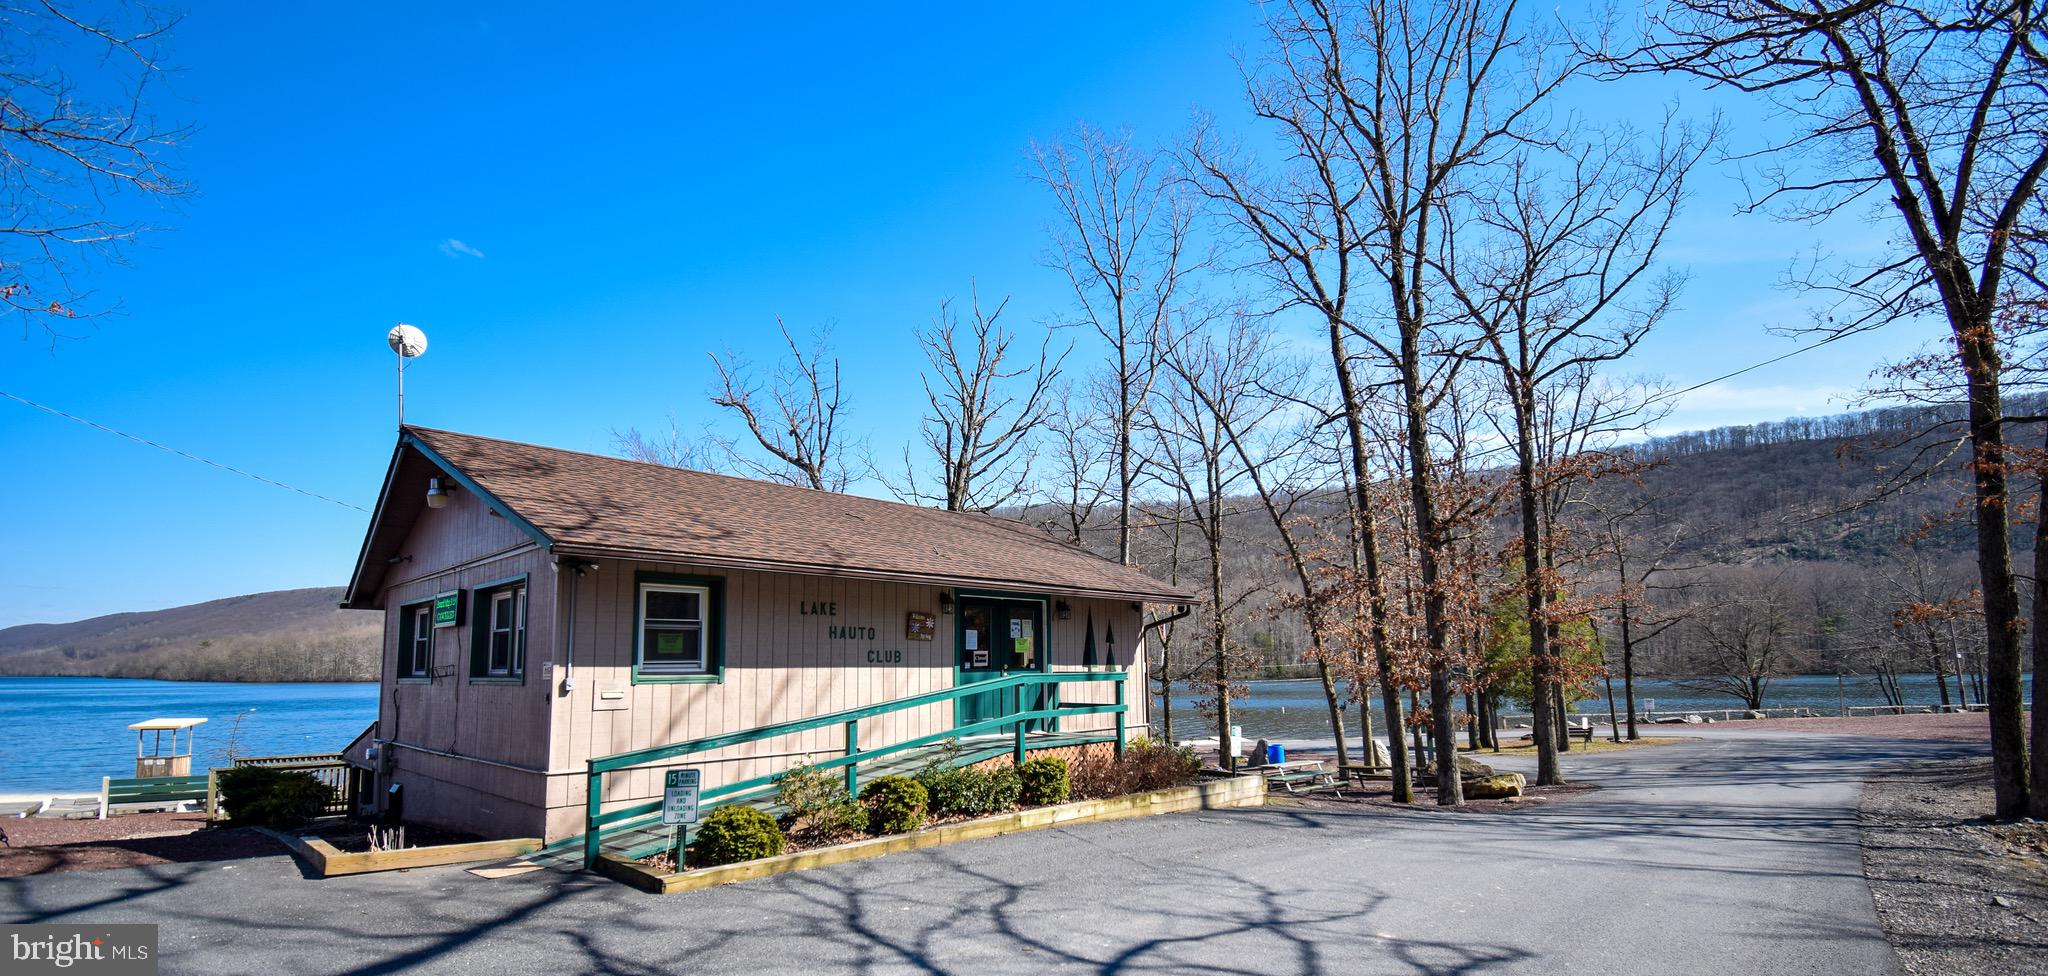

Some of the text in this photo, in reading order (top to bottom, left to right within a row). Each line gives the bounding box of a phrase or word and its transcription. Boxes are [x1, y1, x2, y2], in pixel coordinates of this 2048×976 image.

[800, 601, 837, 616] LAKE
[828, 626, 876, 640] HAUTO
[867, 650, 902, 663] CLUB
[668, 773, 677, 785] 15
